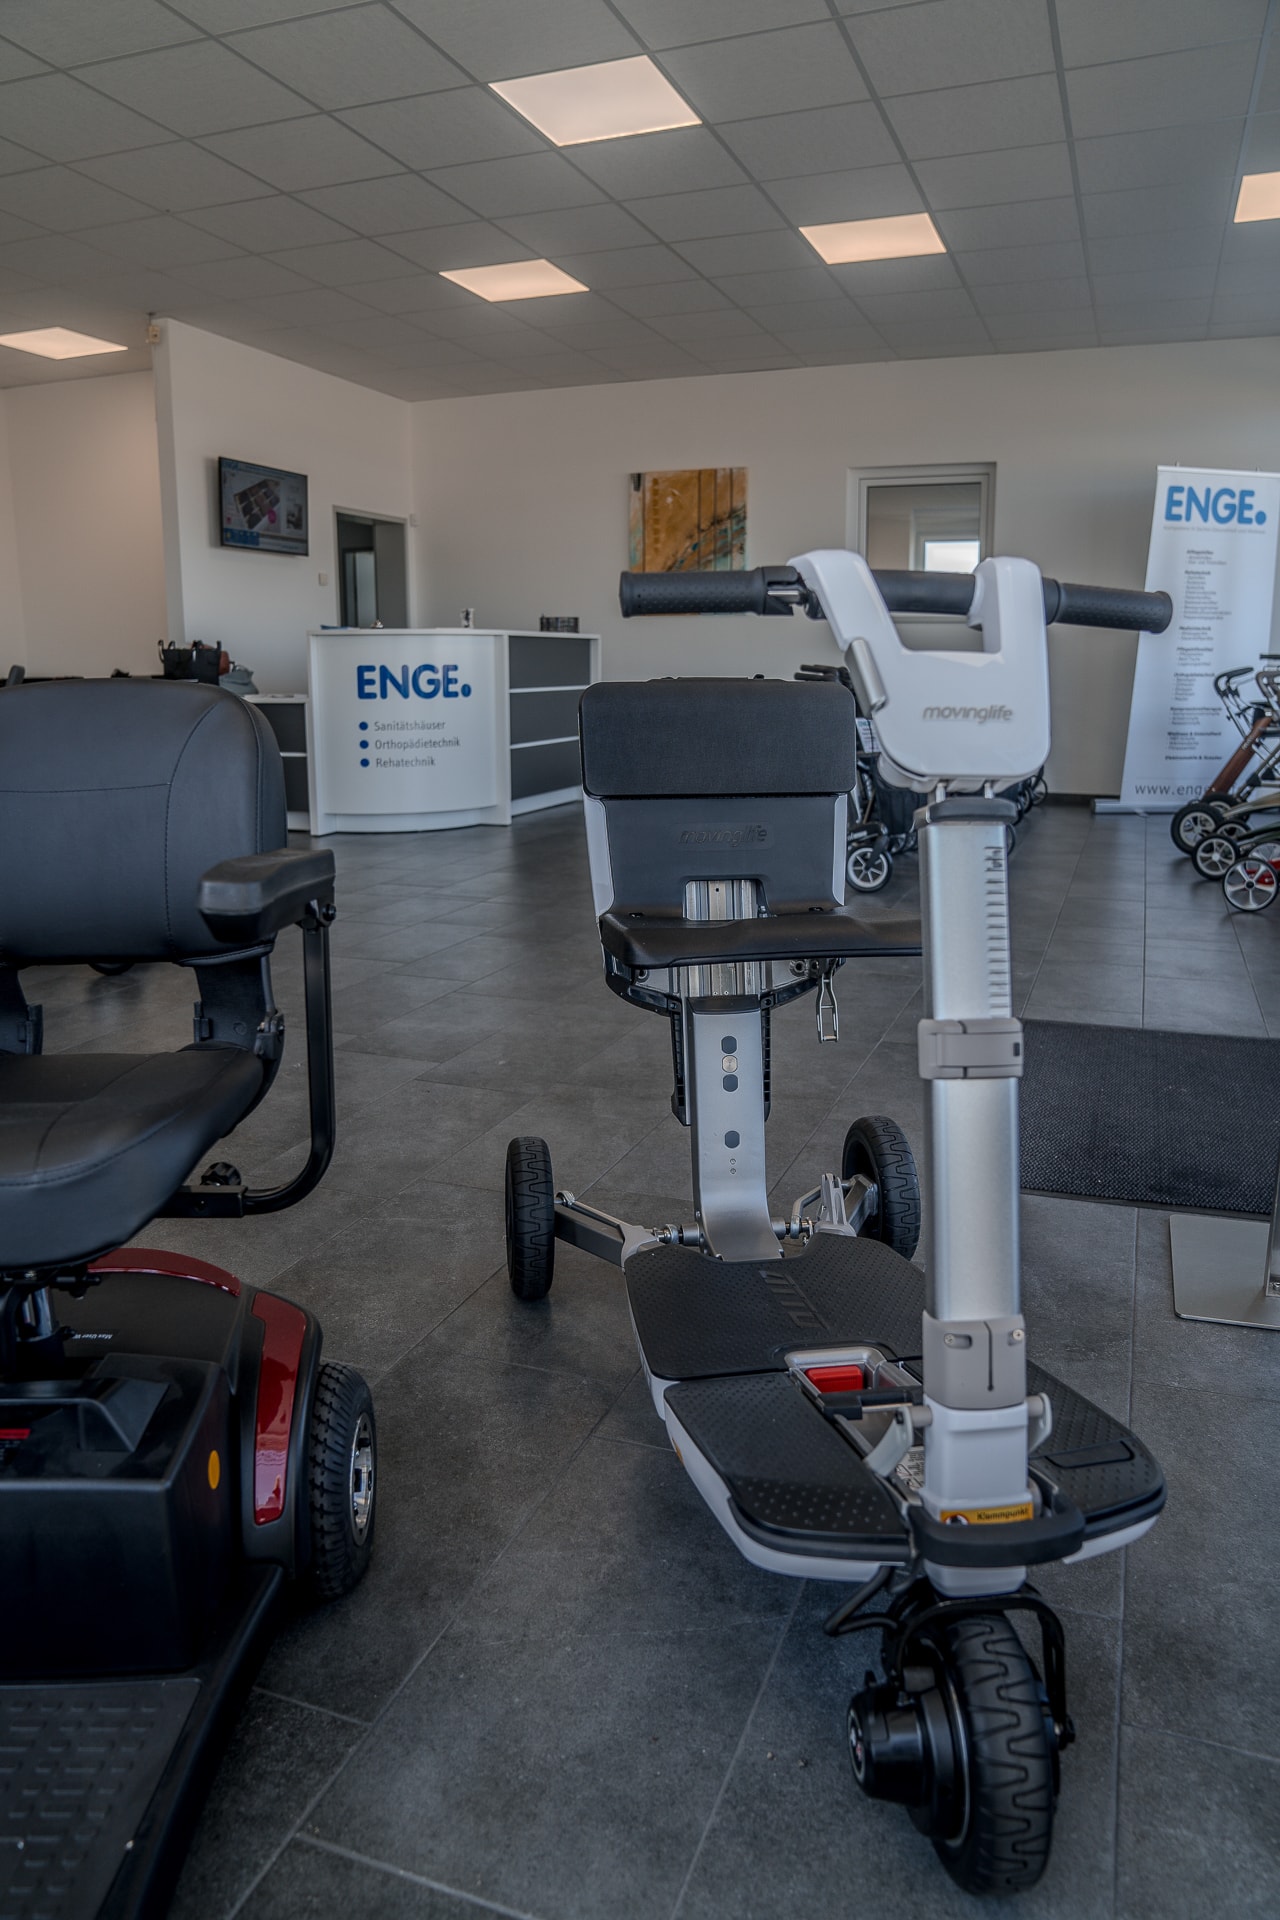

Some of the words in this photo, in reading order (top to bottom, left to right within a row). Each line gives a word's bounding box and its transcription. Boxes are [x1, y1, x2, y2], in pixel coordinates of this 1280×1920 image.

[1165, 486, 1267, 525] ENGE.
[357, 664, 472, 699] ENGE.
[922, 705, 1013, 724] movinglife
[374, 720, 446, 732] Sanitätshäuser
[375, 737, 461, 751] Orthopädietechnik
[375, 757, 436, 768] Rehatechnik
[679, 825, 768, 847] movinglife
